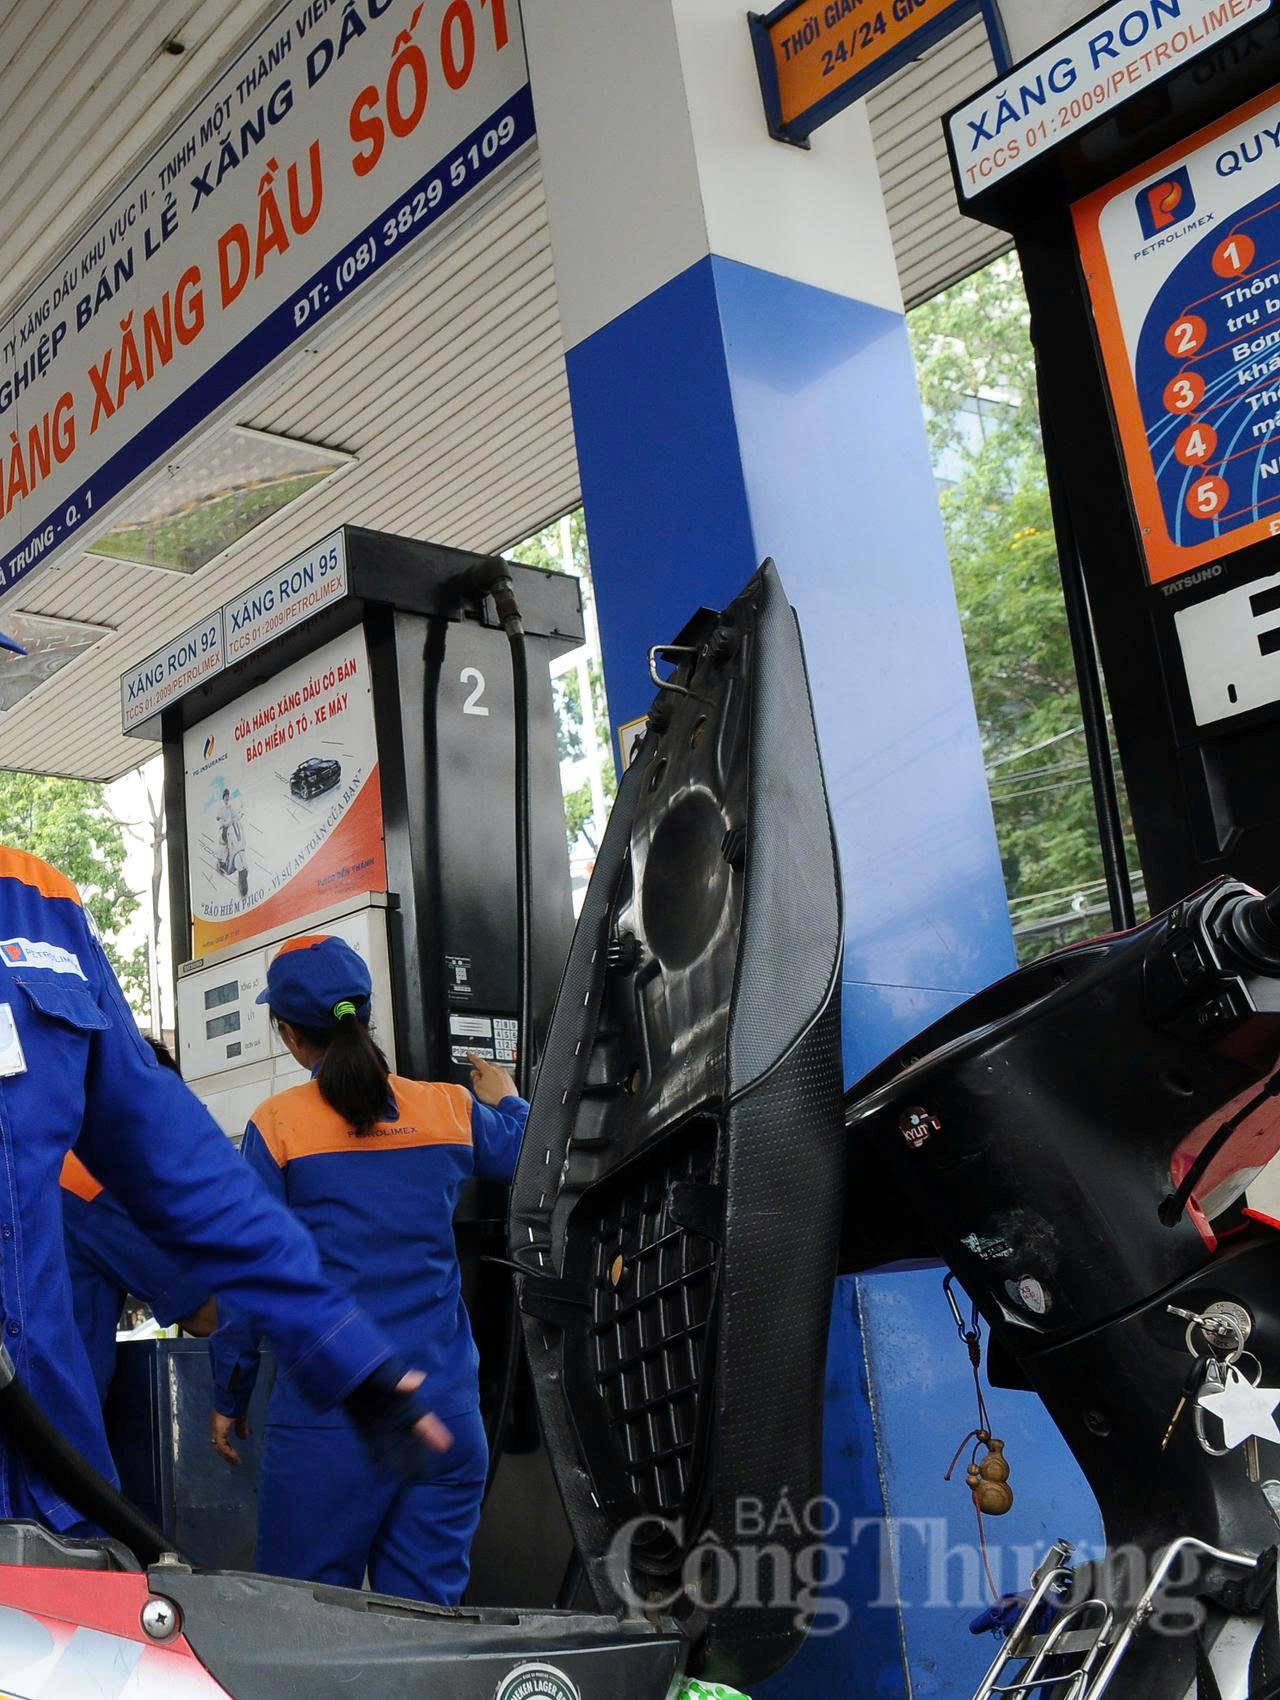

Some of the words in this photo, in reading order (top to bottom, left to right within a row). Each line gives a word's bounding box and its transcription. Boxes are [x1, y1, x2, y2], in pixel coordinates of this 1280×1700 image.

[781, 16, 821, 61] THỜI
[821, 11, 887, 76] 24/24
[966, 139, 1021, 185] TCCS
[1025, 0, 1261, 148] 01:2009/PETROLIME
[968, 57, 1078, 152] XĂNG
[3, 336, 17, 364] TY
[20, 300, 51, 348] XĂNG
[81, 237, 106, 279] KHU
[109, 203, 136, 241] VỰC
[158, 136, 196, 190] TNHH
[200, 95, 233, 147] MỘT
[236, 29, 292, 104] THÀNH
[76, 247, 135, 333] BÁN
[144, 191, 180, 261] LẺ
[190, 79, 294, 213] XĂNG
[87, 265, 205, 435] XĂNG
[217, 138, 323, 311] DẦU
[349, 0, 428, 177] SỐ
[294, 281, 330, 328] ĐT:
[336, 236, 377, 291] (08)
[383, 179, 443, 246] 3829
[449, 115, 515, 188] 5109
[1133, 212, 1215, 261] PETROLIMEX
[1223, 242, 1241, 270] 1
[1221, 274, 1280, 308] Thôn
[1173, 323, 1197, 353] 2
[1227, 309, 1260, 332] trụ
[1238, 353, 1280, 385] khá
[1172, 379, 1195, 408] 3
[1185, 429, 1207, 459] 4
[1197, 481, 1219, 513] 5
[9, 525, 55, 578] TRƯNG
[65, 505, 81, 527] Q.
[85, 490, 93, 510] 1
[231, 590, 275, 633] XĂNG
[279, 563, 314, 602] RON
[319, 547, 338, 577] 95
[1161, 564, 1224, 597] TATSUNO
[128, 672, 164, 702] XĂNG
[168, 639, 197, 675] RON
[201, 626, 217, 653] 92
[229, 633, 251, 656] TCCS
[125, 700, 144, 722] TCCS
[252, 709, 276, 731] HÀNG
[277, 691, 301, 717] XĂNG
[322, 667, 336, 691] CÓ
[337, 658, 357, 682] BÁN
[314, 706, 326, 725] XE
[328, 693, 349, 718] MÁY
[460, 667, 489, 716] 2
[348, 1126, 417, 1138] POLIMEX
[534, 1680, 558, 1696] LAGER
